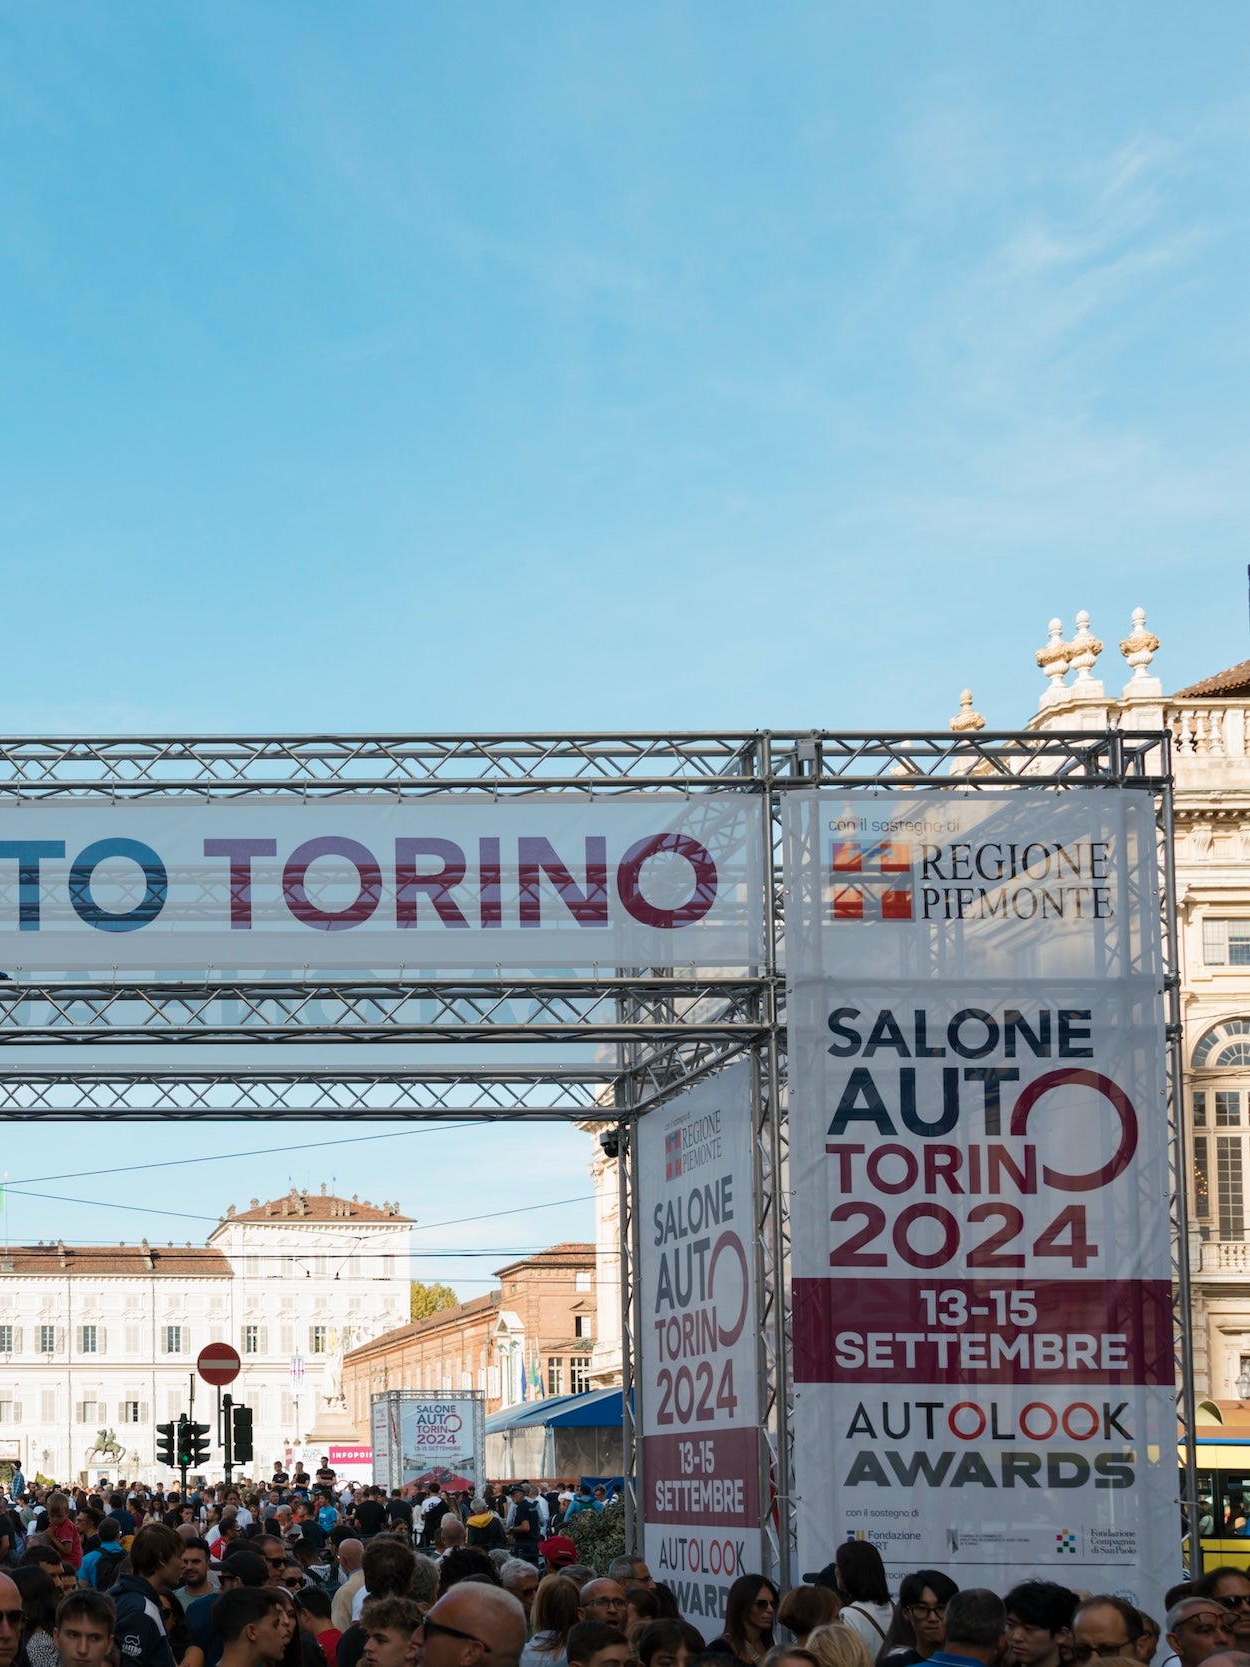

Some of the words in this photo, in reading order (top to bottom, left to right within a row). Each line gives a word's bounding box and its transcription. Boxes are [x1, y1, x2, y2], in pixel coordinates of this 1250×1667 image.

[829, 820, 855, 831] con
[860, 818, 866, 831] il
[871, 819, 942, 836] sostegno
[947, 818, 959, 832] di
[920, 842, 1111, 881] REGIONE
[204, 833, 718, 931] TORINO
[921, 887, 1114, 920] PIEMONTE
[827, 1007, 1093, 1060] SALONE
[682, 1109, 721, 1150] REGIONE
[683, 1137, 722, 1173] PIEMONTE
[654, 1174, 733, 1247] SALONE
[829, 1201, 1098, 1269] 2024
[920, 1289, 1037, 1327] 13-15
[834, 1331, 1128, 1370] SETTEMBRE
[416, 1405, 456, 1413] SALONE
[656, 1359, 737, 1426] 2024
[417, 1434, 457, 1445] 2024
[845, 1401, 1135, 1441] AUTOLOOK
[678, 1440, 715, 1475] 13-15
[843, 1450, 1135, 1489] AWARDS
[655, 1479, 744, 1513] SETTEMBRE
[870, 1510, 909, 1518] sostegno
[912, 1509, 919, 1517] di
[868, 1531, 921, 1540] Fondazione
[1090, 1529, 1135, 1537] Fondazione
[1090, 1537, 1135, 1546] Compagnia
[659, 1537, 746, 1576] AUTOLOOK
